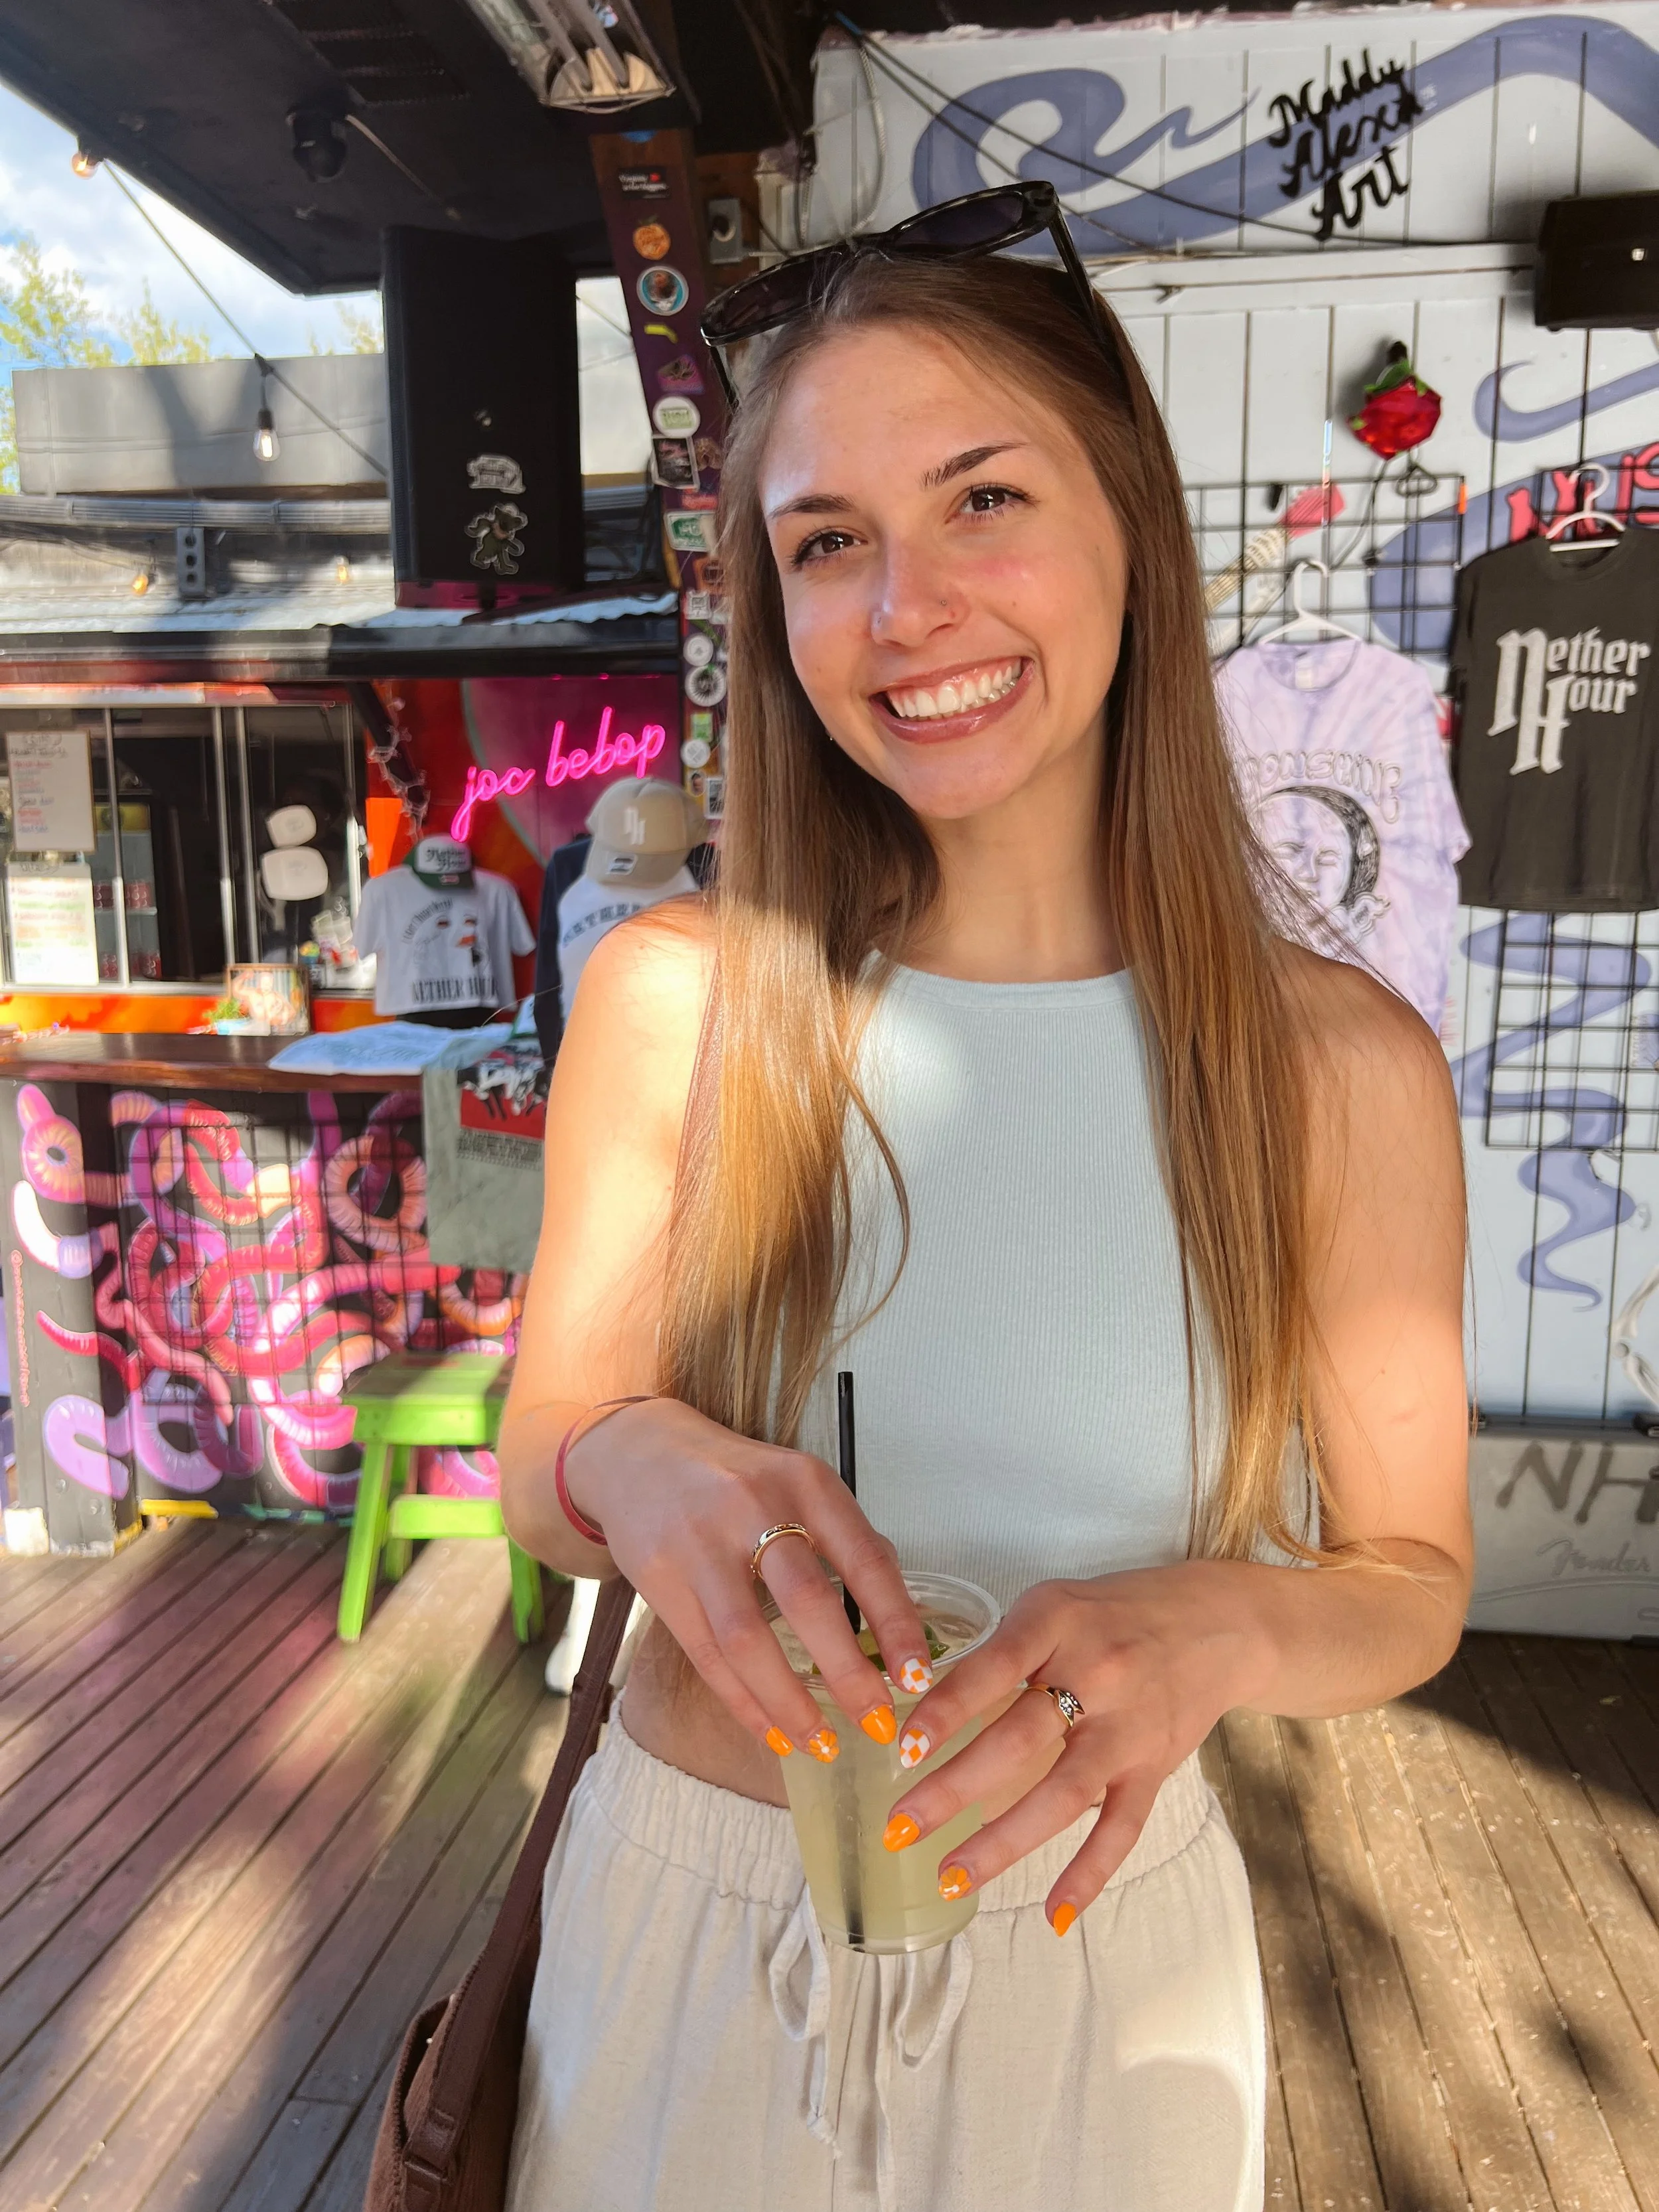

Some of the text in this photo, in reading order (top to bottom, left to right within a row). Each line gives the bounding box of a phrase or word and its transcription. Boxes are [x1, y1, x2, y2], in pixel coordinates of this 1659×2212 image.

[1311, 145, 1409, 241] Art
[545, 705, 666, 786] bebop
[1496, 1439, 1659, 1524] NH
